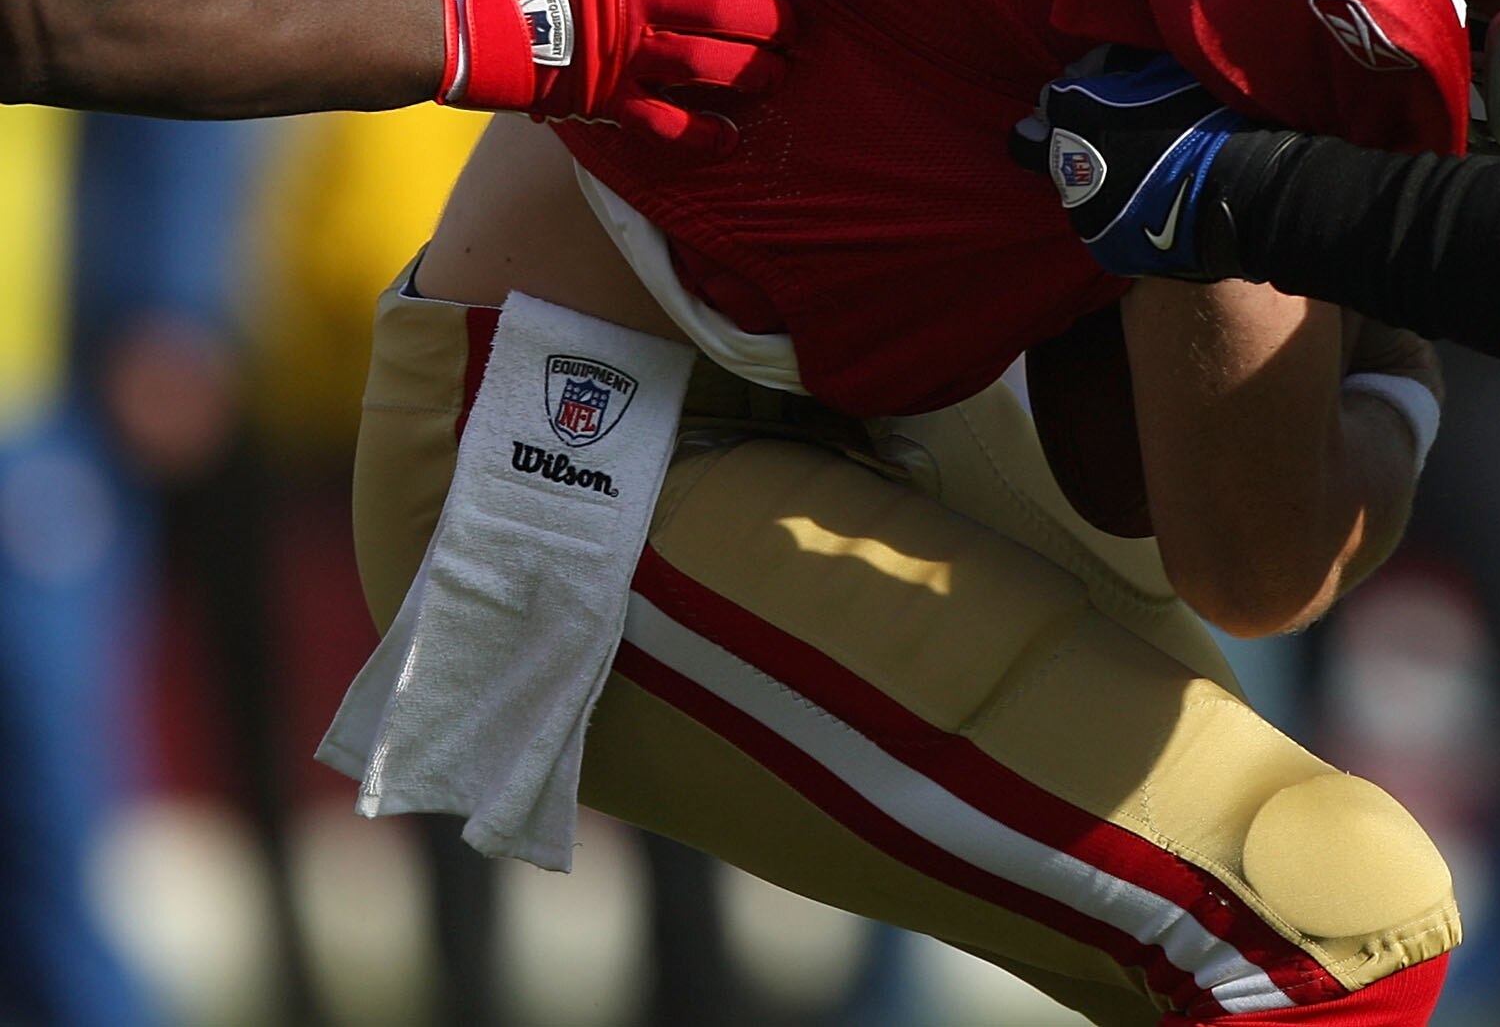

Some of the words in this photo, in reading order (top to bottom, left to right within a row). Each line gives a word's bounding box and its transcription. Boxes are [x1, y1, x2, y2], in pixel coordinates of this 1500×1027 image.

[551, 359, 633, 394] EQUIPMENT
[559, 401, 597, 433] NFL
[511, 440, 615, 496] Wilson
